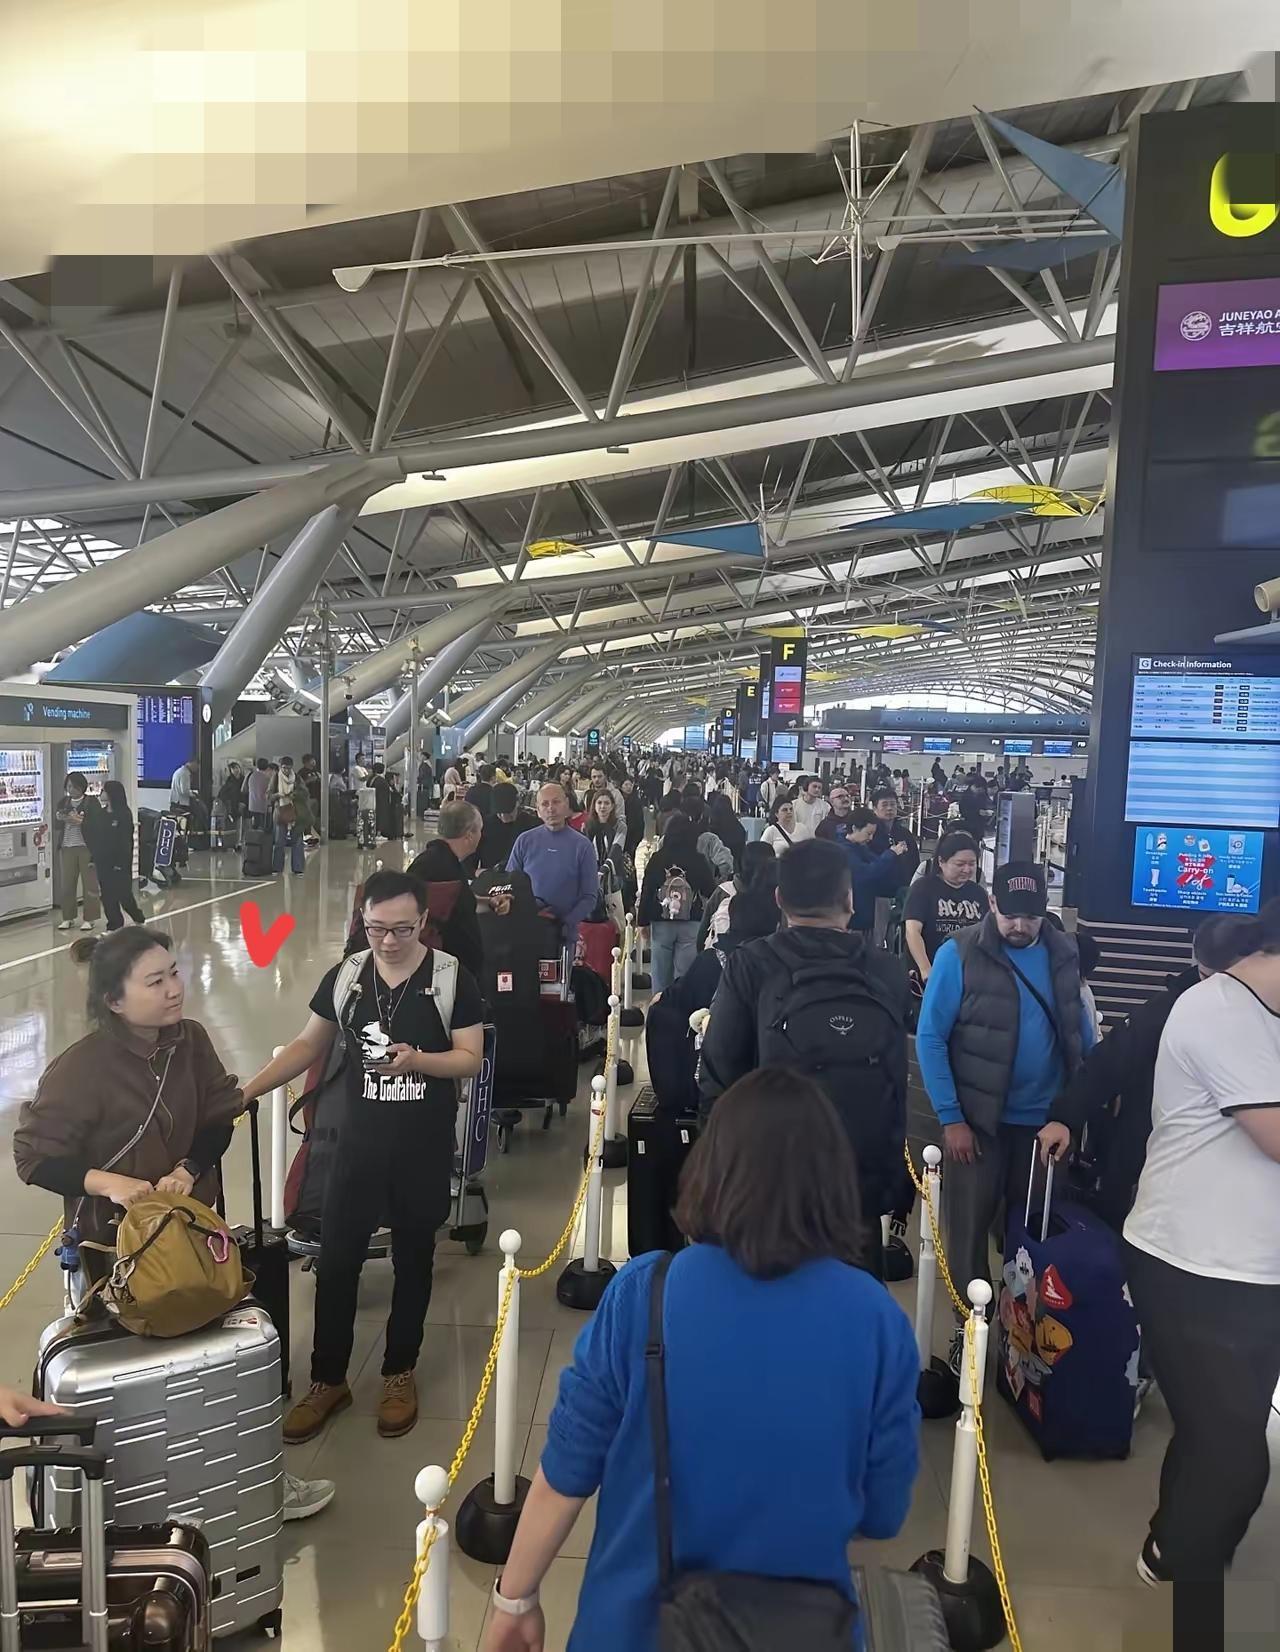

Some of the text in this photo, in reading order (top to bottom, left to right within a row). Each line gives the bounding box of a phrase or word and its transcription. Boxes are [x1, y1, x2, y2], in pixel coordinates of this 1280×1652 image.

[1219, 309, 1273, 322] JUNEYAO
[783, 643, 795, 660] F
[1141, 659, 1232, 668] G Check-in Information
[747, 686, 755, 697] E
[43, 704, 91, 720] Vending machine
[725, 709, 732, 718] D
[160, 829, 172, 856] DHC
[1177, 865, 1214, 875] Carry-on
[362, 1069, 427, 1102] The Godfather
[475, 1057, 491, 1142] DHC
